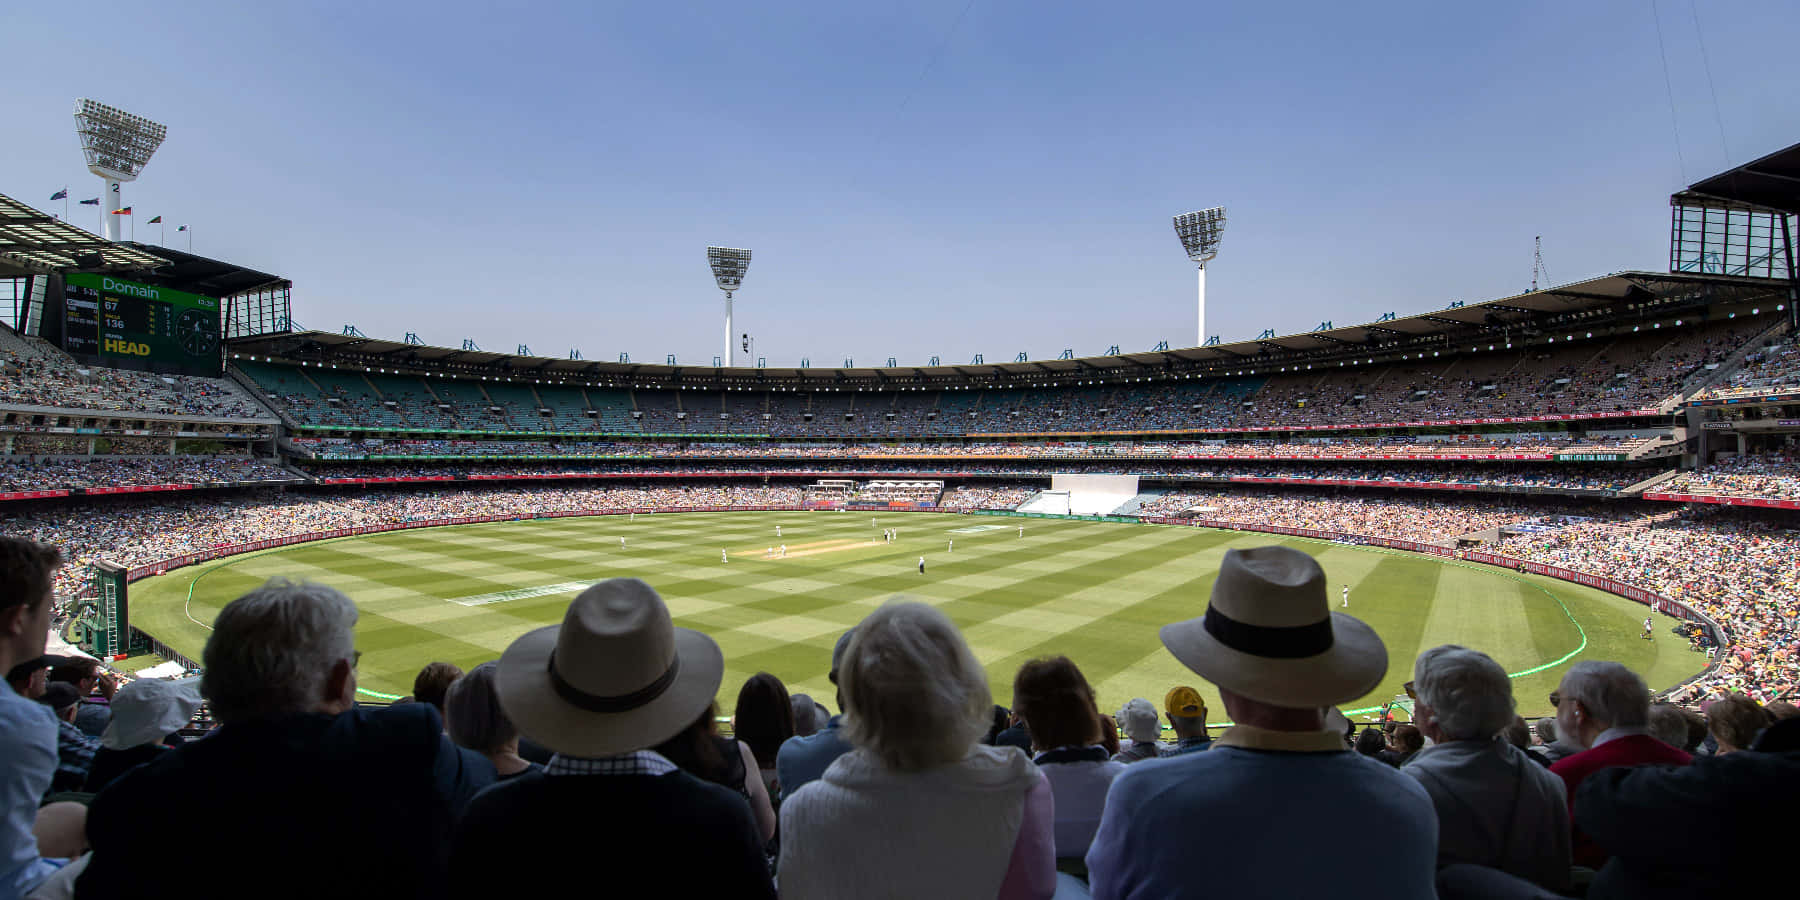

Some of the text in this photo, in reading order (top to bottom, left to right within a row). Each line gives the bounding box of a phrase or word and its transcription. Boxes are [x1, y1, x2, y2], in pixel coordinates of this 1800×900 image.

[111, 183, 120, 193] 2
[103, 278, 159, 299] Domain
[105, 301, 118, 311] 67
[106, 318, 125, 329] 136
[104, 338, 151, 356] HEAD
